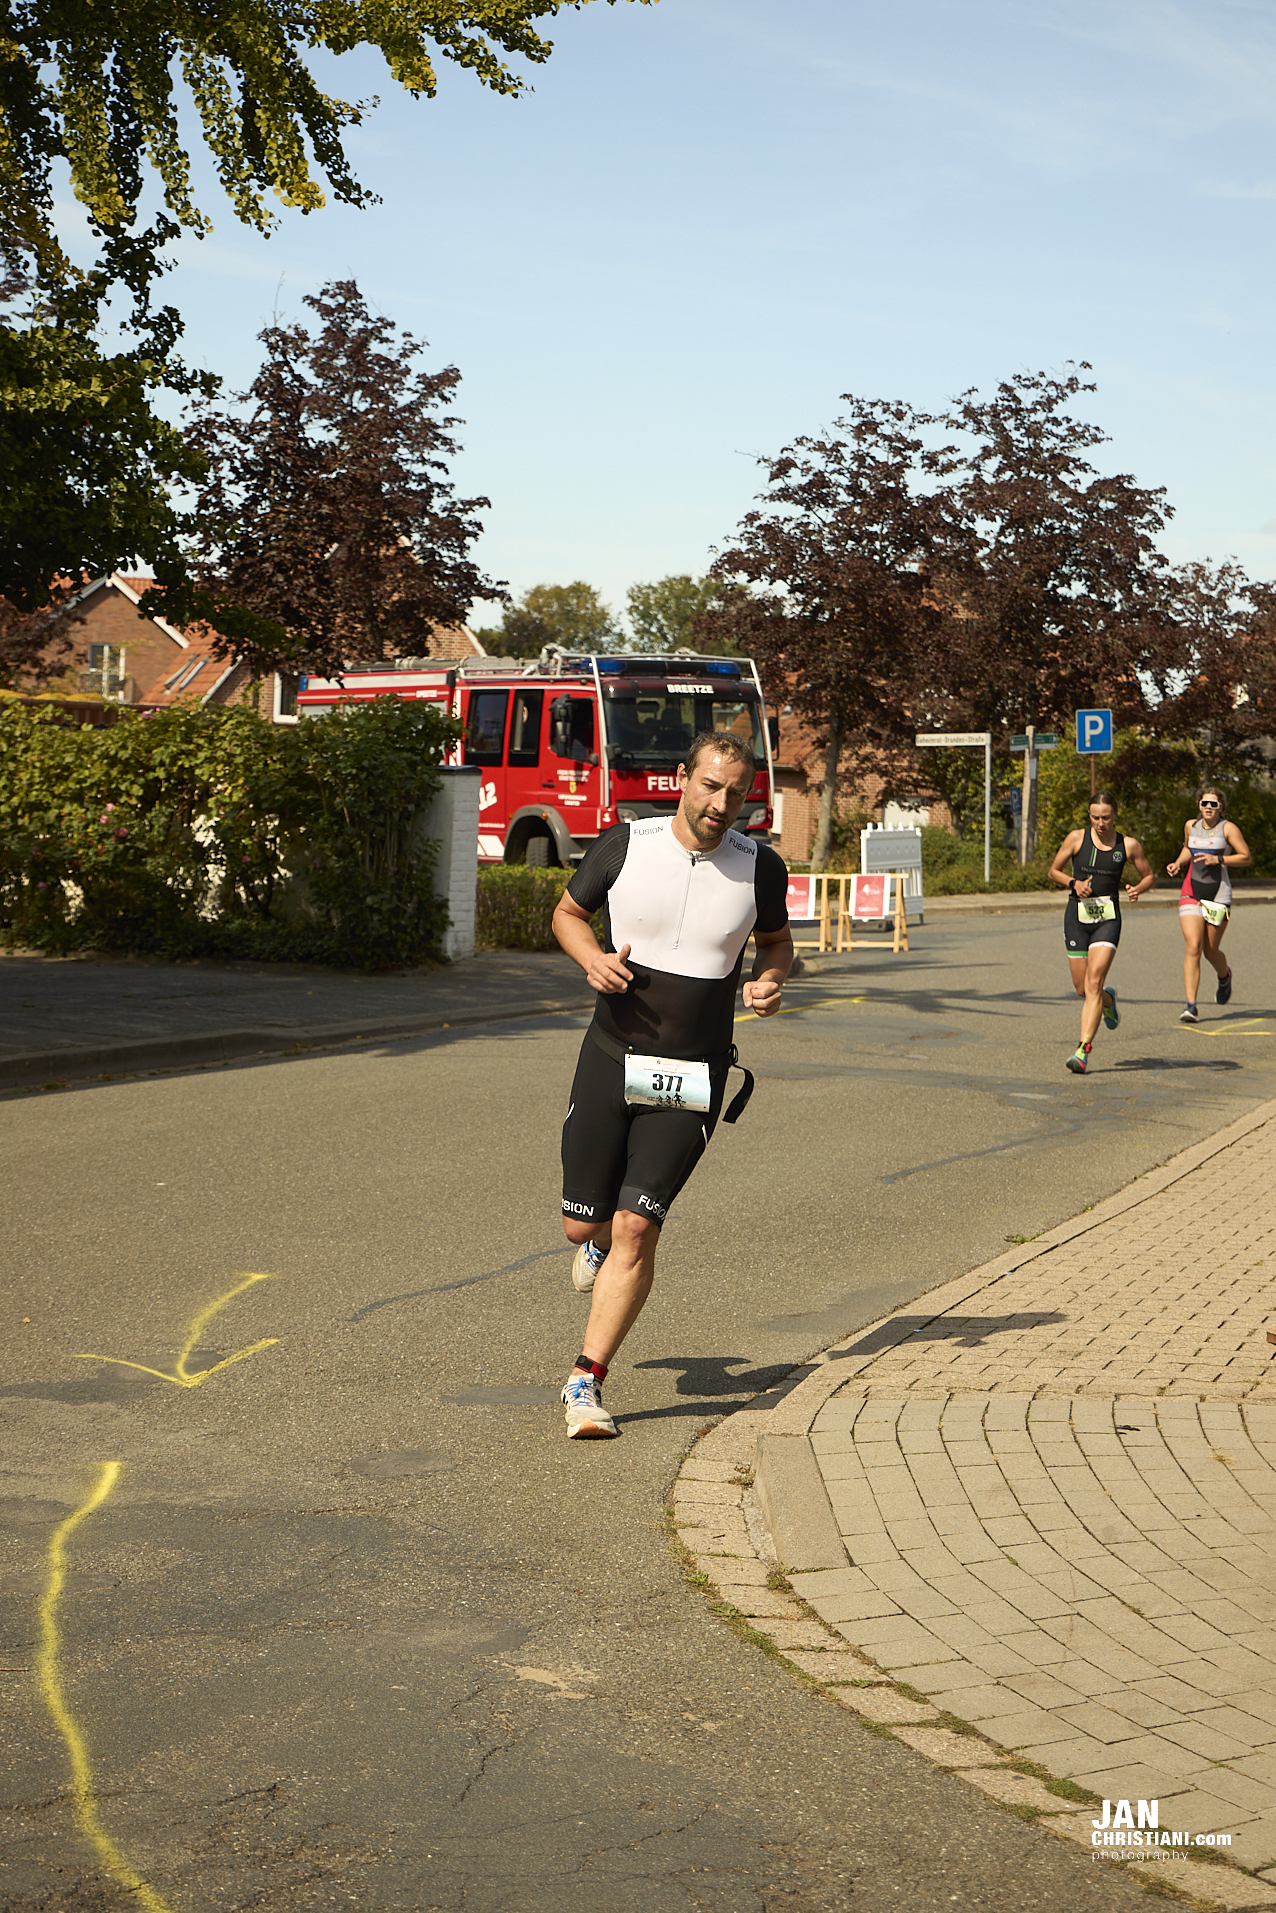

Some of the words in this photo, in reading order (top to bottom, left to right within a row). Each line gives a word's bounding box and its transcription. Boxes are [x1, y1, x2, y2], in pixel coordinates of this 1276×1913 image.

[667, 684, 714, 694] BREETZE
[1084, 715, 1104, 748] P
[633, 826, 664, 836] FUSION
[729, 837, 756, 856] FUSION
[1088, 906, 1104, 915] 523
[652, 1073, 683, 1092] 377
